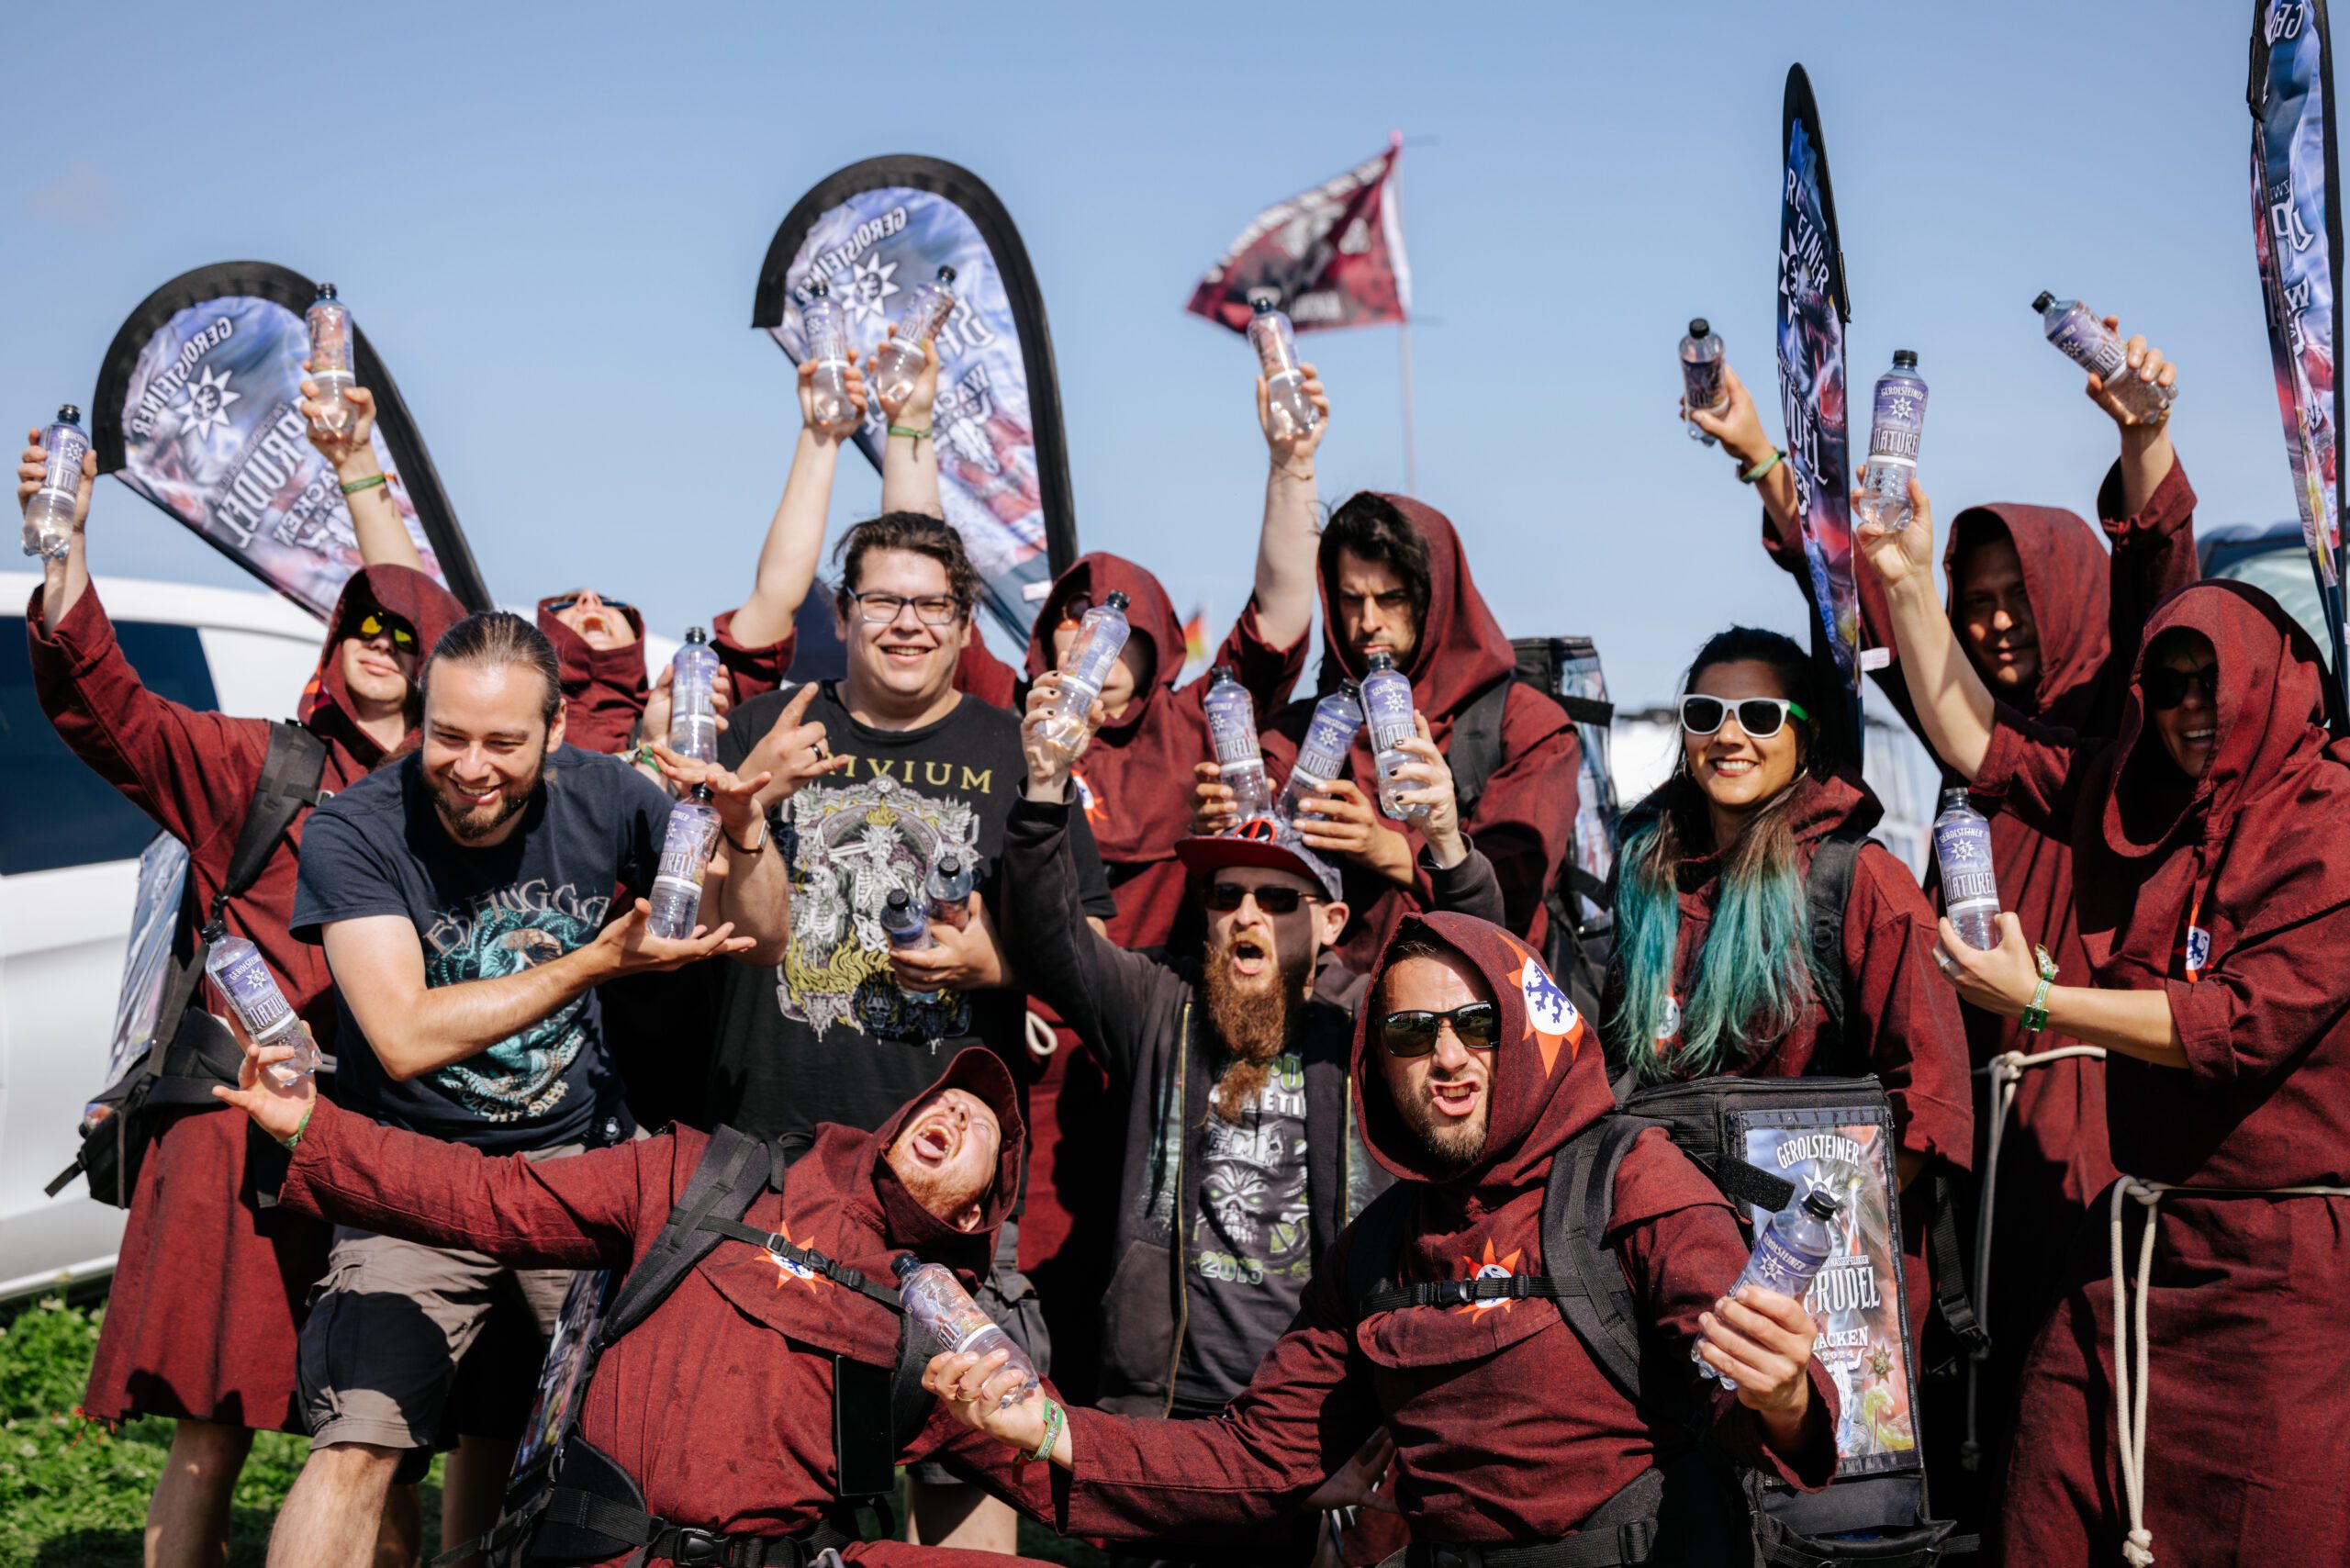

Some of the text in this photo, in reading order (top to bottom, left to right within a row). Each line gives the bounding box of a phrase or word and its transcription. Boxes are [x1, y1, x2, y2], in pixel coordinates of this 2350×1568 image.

[1881, 386, 1924, 402] GEROLSTEINER
[826, 751, 992, 794] IVIUM
[1939, 827, 1984, 844] GEROLSTEINER
[1776, 1134, 1860, 1170] GEROLSTEINER
[1763, 1232, 1807, 1271] GEROLSTEINER
[1812, 1326, 1869, 1351] ACKEN
